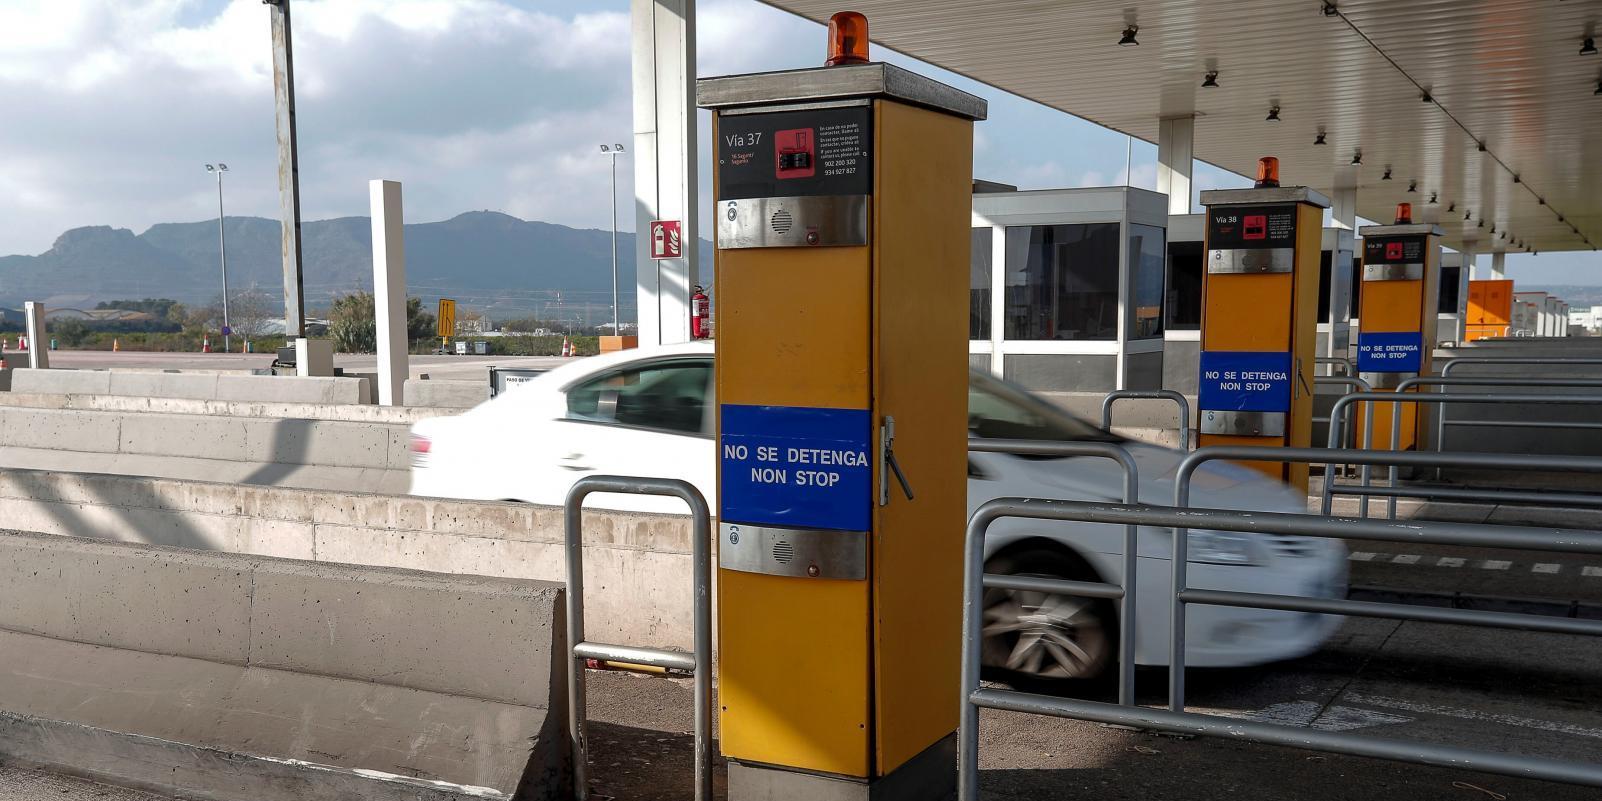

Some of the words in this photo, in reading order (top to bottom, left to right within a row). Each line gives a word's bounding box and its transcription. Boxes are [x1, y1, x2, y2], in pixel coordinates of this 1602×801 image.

[726, 134, 744, 147] Vía
[747, 132, 762, 146] 37
[1206, 371, 1219, 379] NO
[1224, 371, 1237, 380] SE
[1241, 372, 1287, 380] DETENGA
[1245, 383, 1271, 391] STOP
[724, 445, 748, 460] NO
[757, 446, 778, 462] SE
[787, 448, 868, 467] DETENGA
[751, 468, 786, 484] NON
[795, 470, 840, 486] STOP
